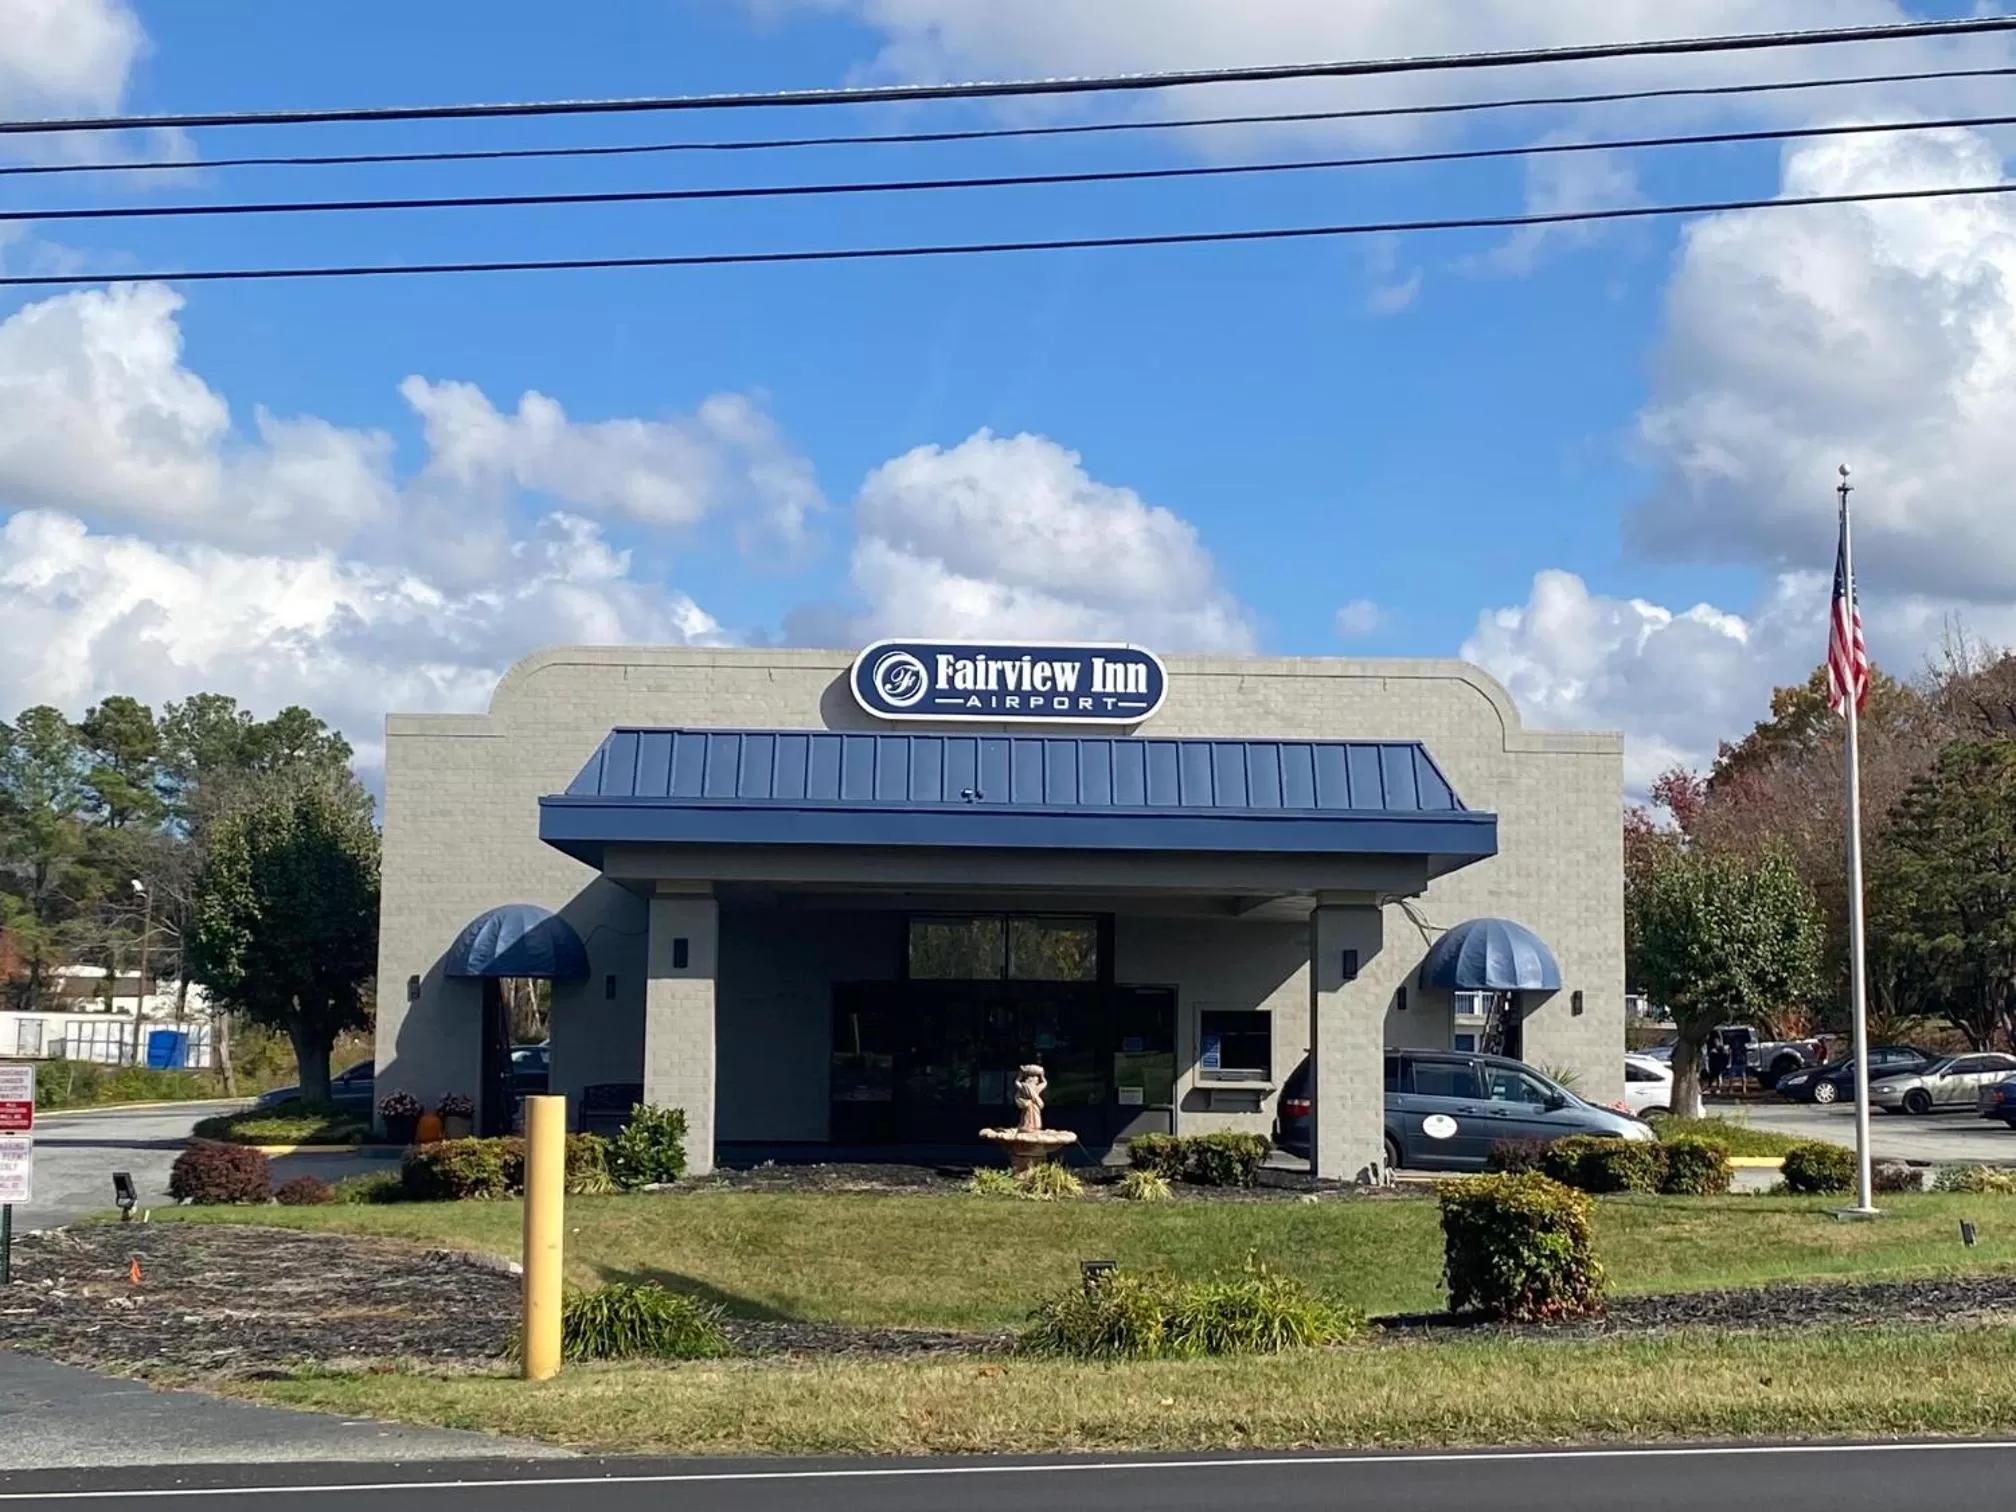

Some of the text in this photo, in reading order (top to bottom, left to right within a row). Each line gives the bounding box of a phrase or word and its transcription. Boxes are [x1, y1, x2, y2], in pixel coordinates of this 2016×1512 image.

[935, 653, 1149, 693] Fairview Inn
[966, 696, 1118, 710] AIRPORT
